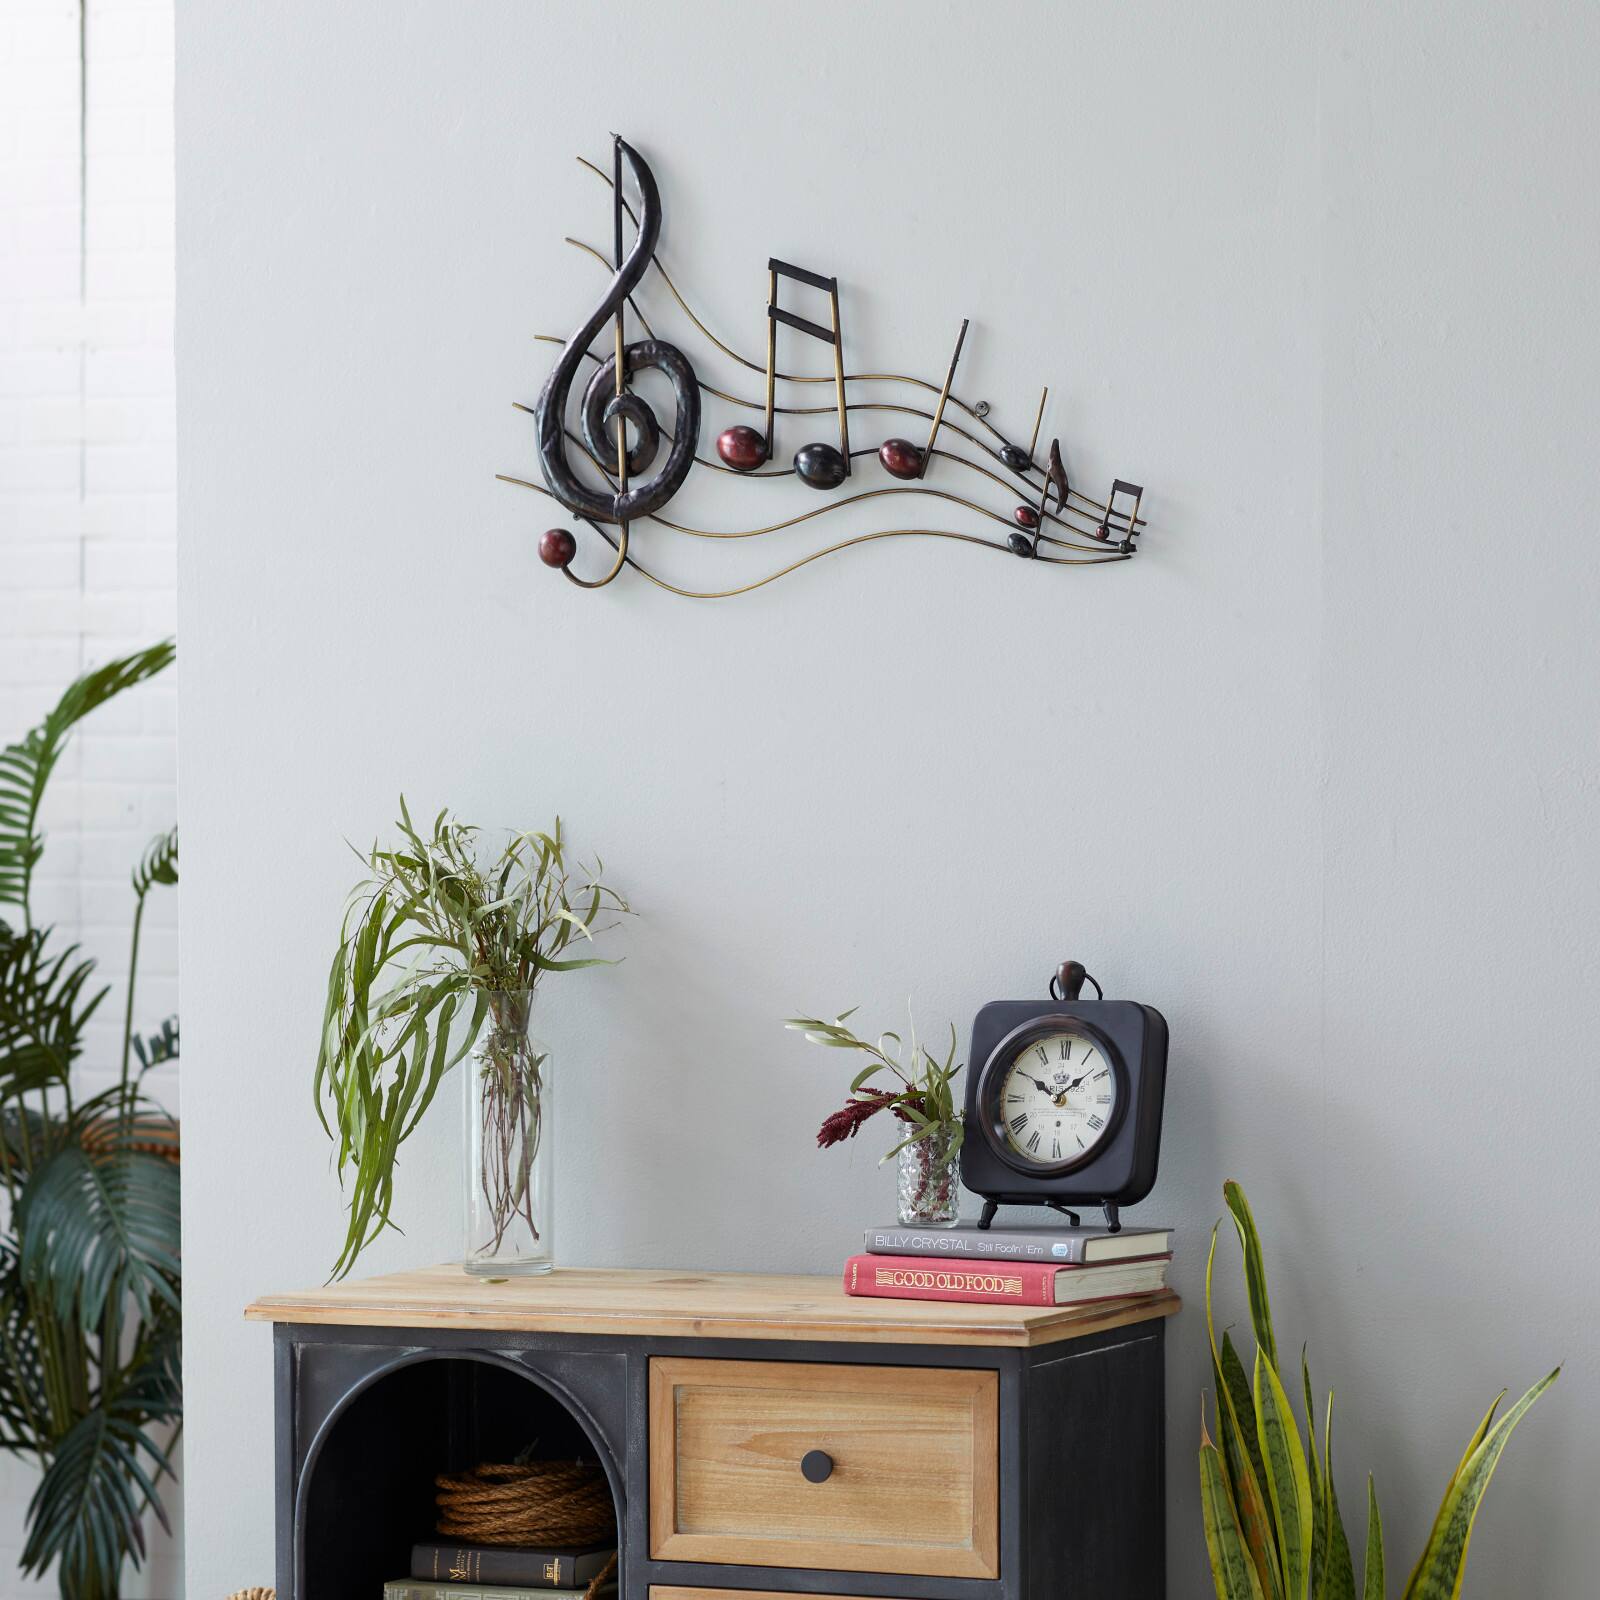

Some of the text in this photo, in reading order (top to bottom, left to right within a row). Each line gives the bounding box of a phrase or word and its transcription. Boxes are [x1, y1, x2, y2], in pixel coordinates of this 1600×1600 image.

[1059, 1040, 1072, 1060] XII
[875, 1236, 909, 1247] BILLY
[911, 1237, 972, 1251] CRYSTAL
[977, 1242, 993, 1252] Still
[995, 1243, 1023, 1254] Foolin'
[1025, 1245, 1044, 1254] 'Em
[893, 1272, 1004, 1292] GOOD OLD FOOD
